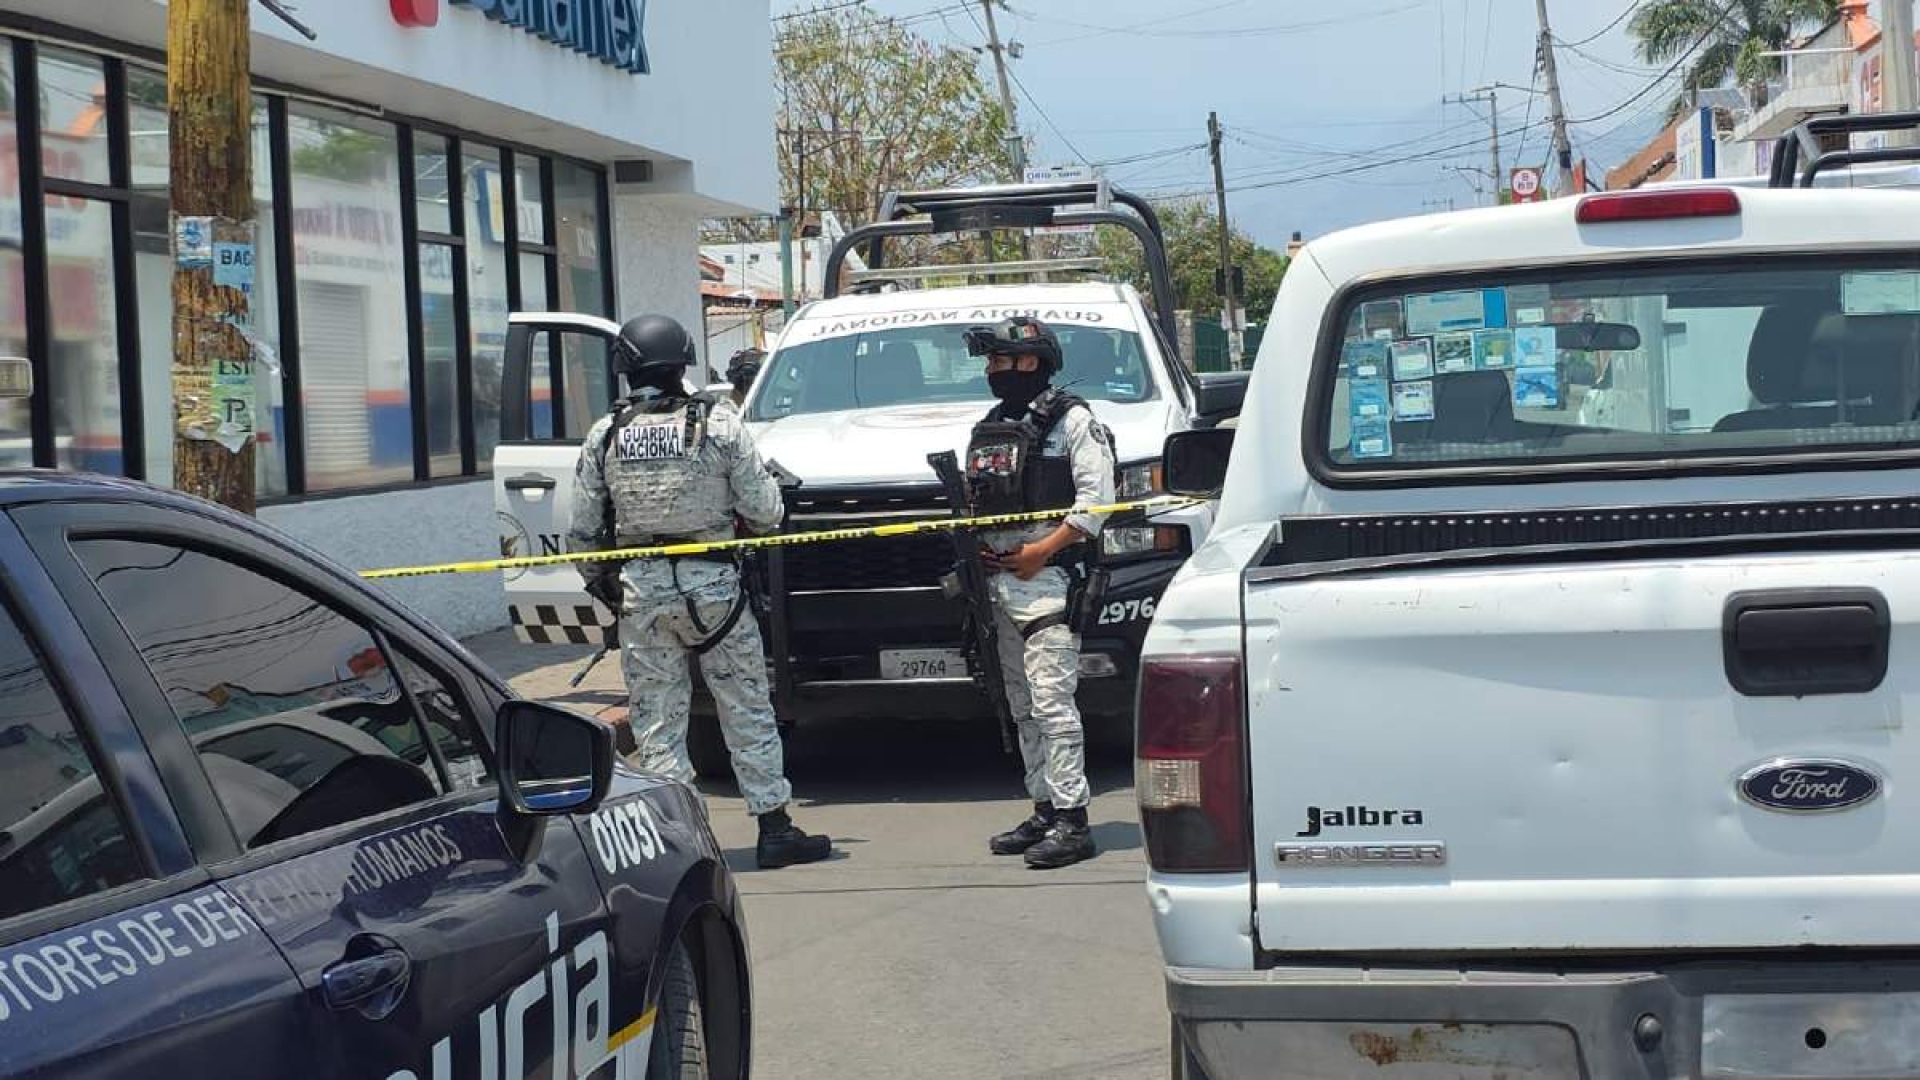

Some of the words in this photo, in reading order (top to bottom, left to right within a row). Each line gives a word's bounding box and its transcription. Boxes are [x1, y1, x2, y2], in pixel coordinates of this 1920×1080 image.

[624, 425, 679, 442] GUARDIA
[619, 440, 684, 459] NACIONAL
[901, 659, 947, 678] 29764
[1770, 769, 1849, 799] Ford
[1295, 805, 1424, 838] Jalbra
[590, 799, 667, 875] 01031
[1276, 844, 1445, 866] RANGER
[0, 928, 138, 1022] TORES
[118, 910, 193, 966] DE
[171, 860, 341, 948] DERECHO
[346, 823, 462, 895] HUMANOS
